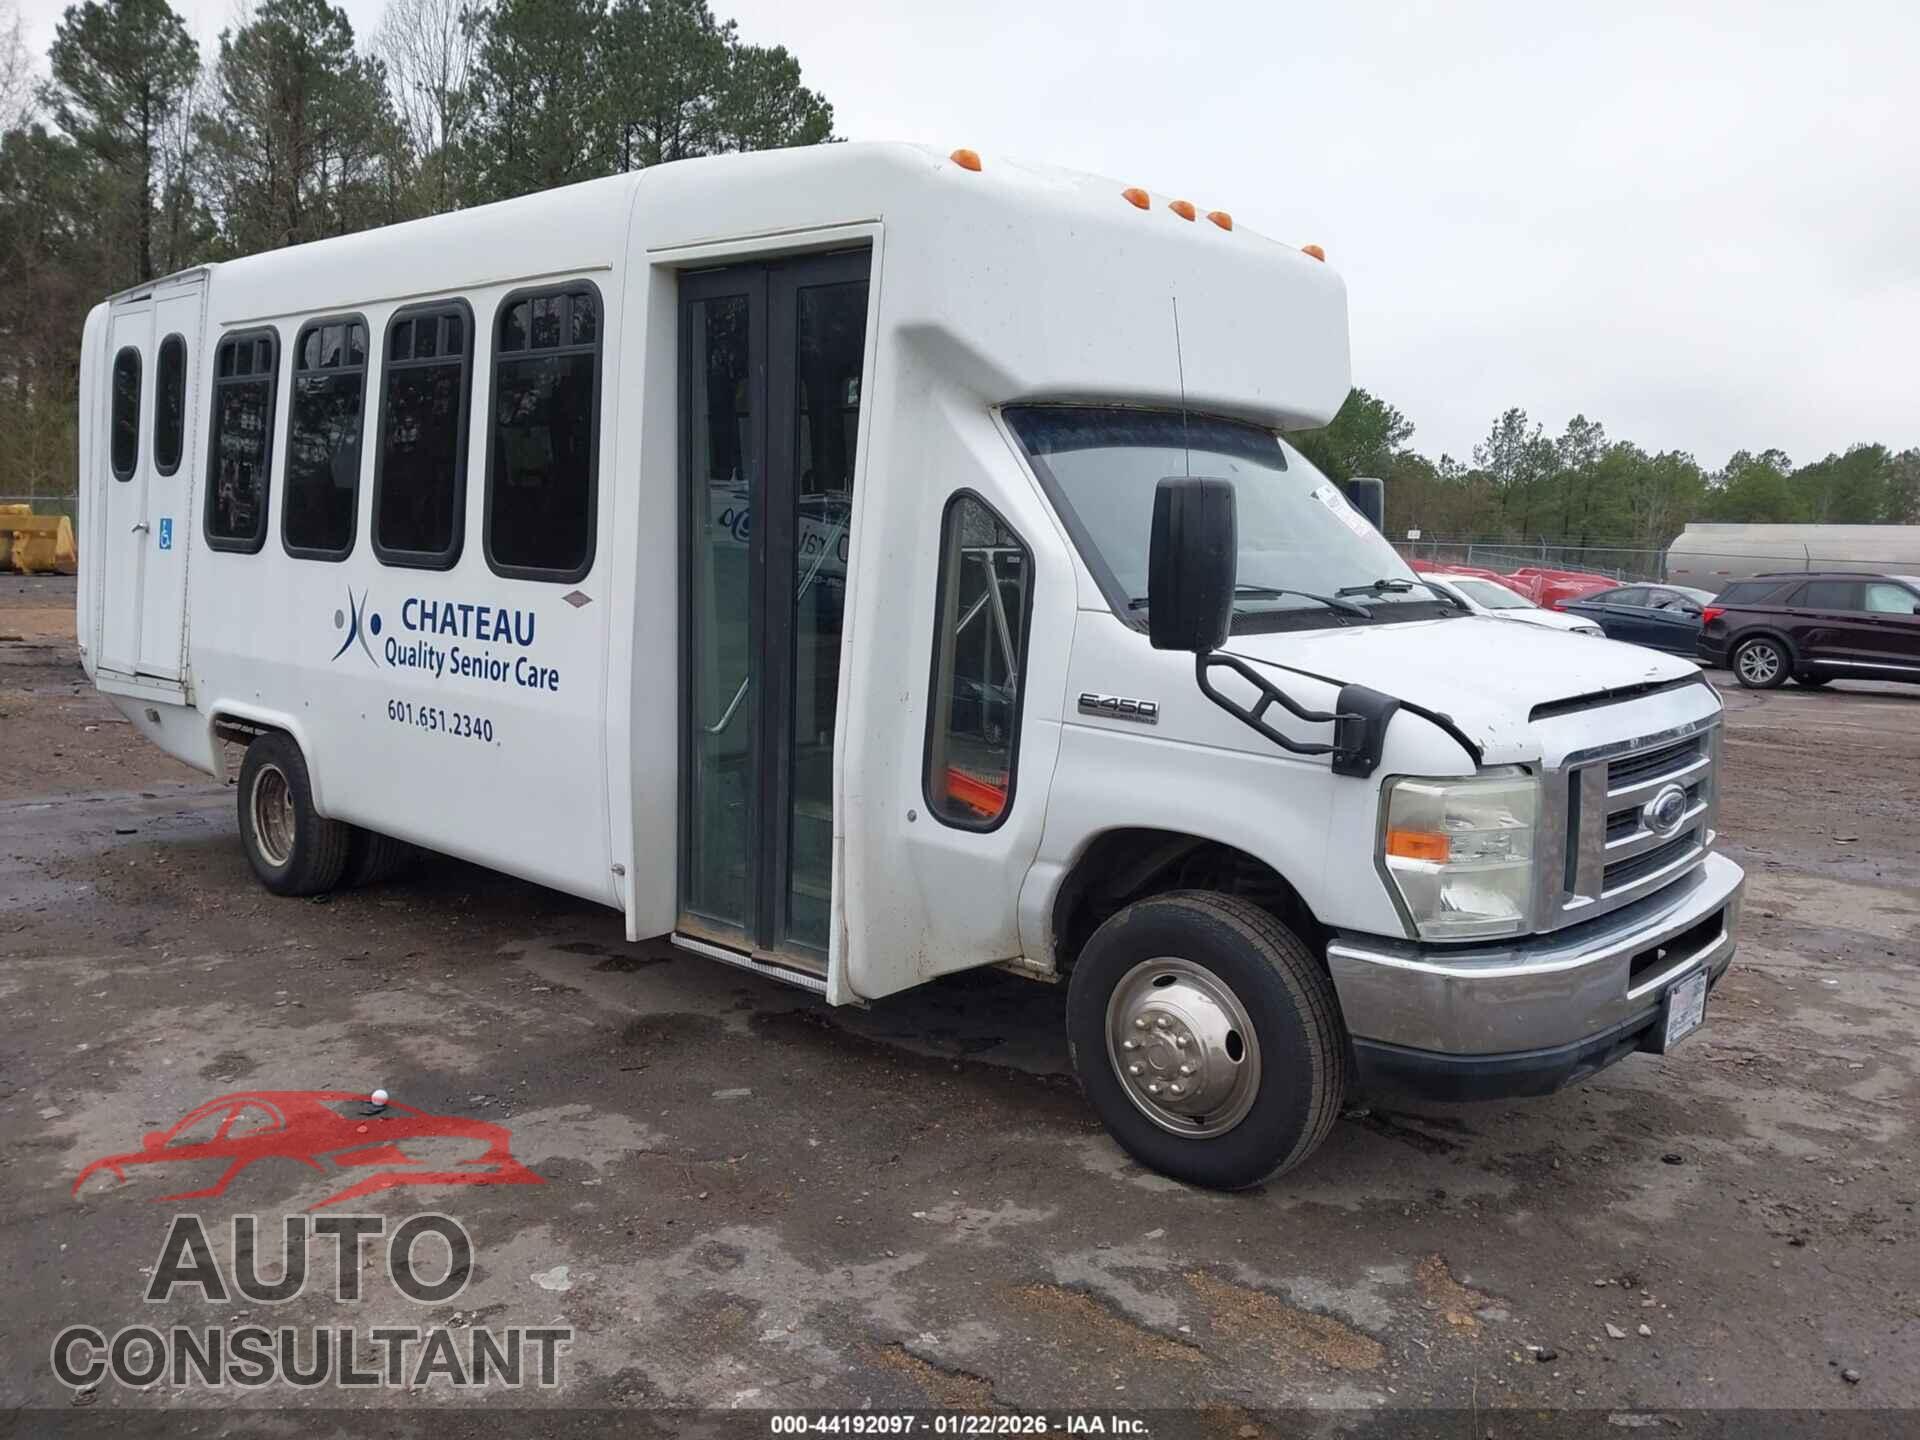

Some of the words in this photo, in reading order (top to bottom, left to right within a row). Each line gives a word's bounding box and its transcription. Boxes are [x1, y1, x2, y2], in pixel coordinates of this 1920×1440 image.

[402, 598, 535, 646] CHATEAU
[384, 637, 446, 678] Quality
[450, 646, 510, 683] Senior
[515, 656, 559, 691] Care
[388, 699, 493, 742] 601.651.2340
